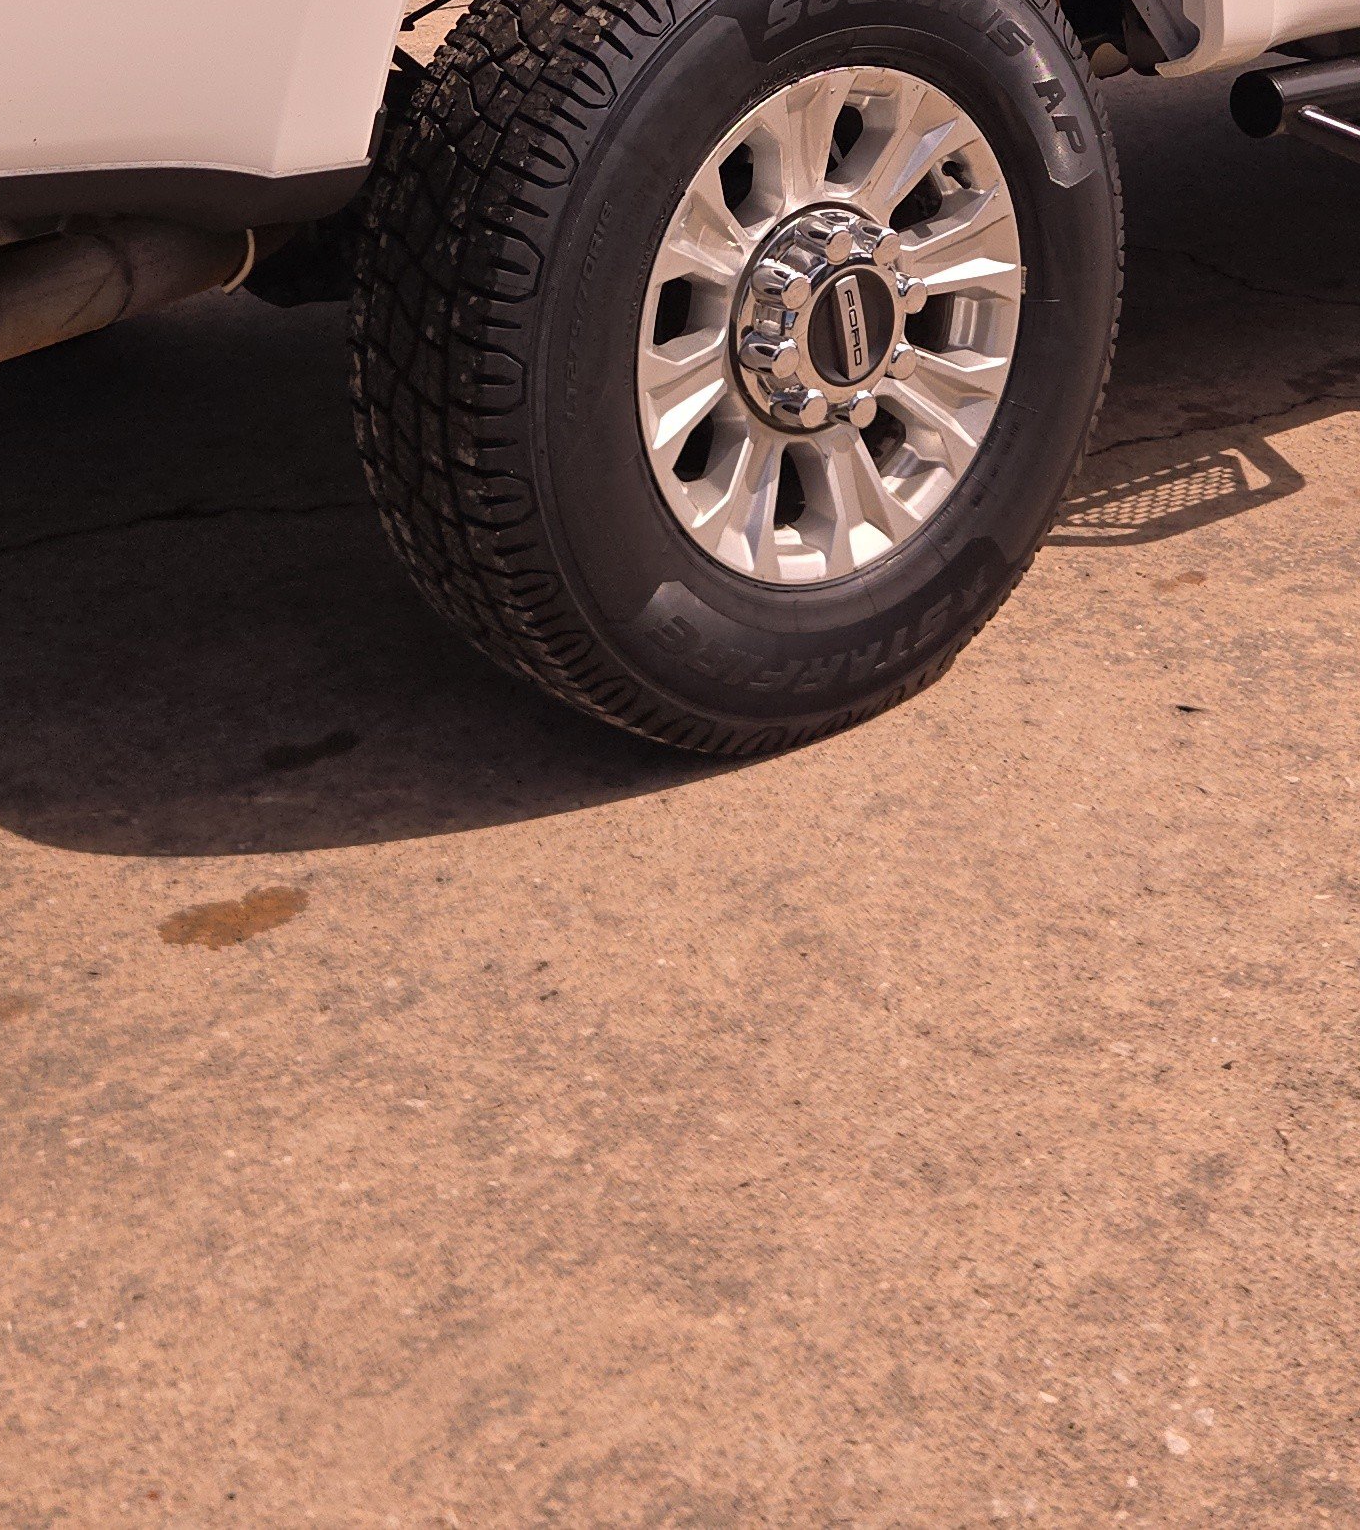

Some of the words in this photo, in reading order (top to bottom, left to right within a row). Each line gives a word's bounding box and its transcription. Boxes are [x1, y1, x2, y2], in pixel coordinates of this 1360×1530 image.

[1032, 78, 1087, 155] AP
[844, 289, 862, 367] FORD
[643, 592, 954, 694] STARFIRE
